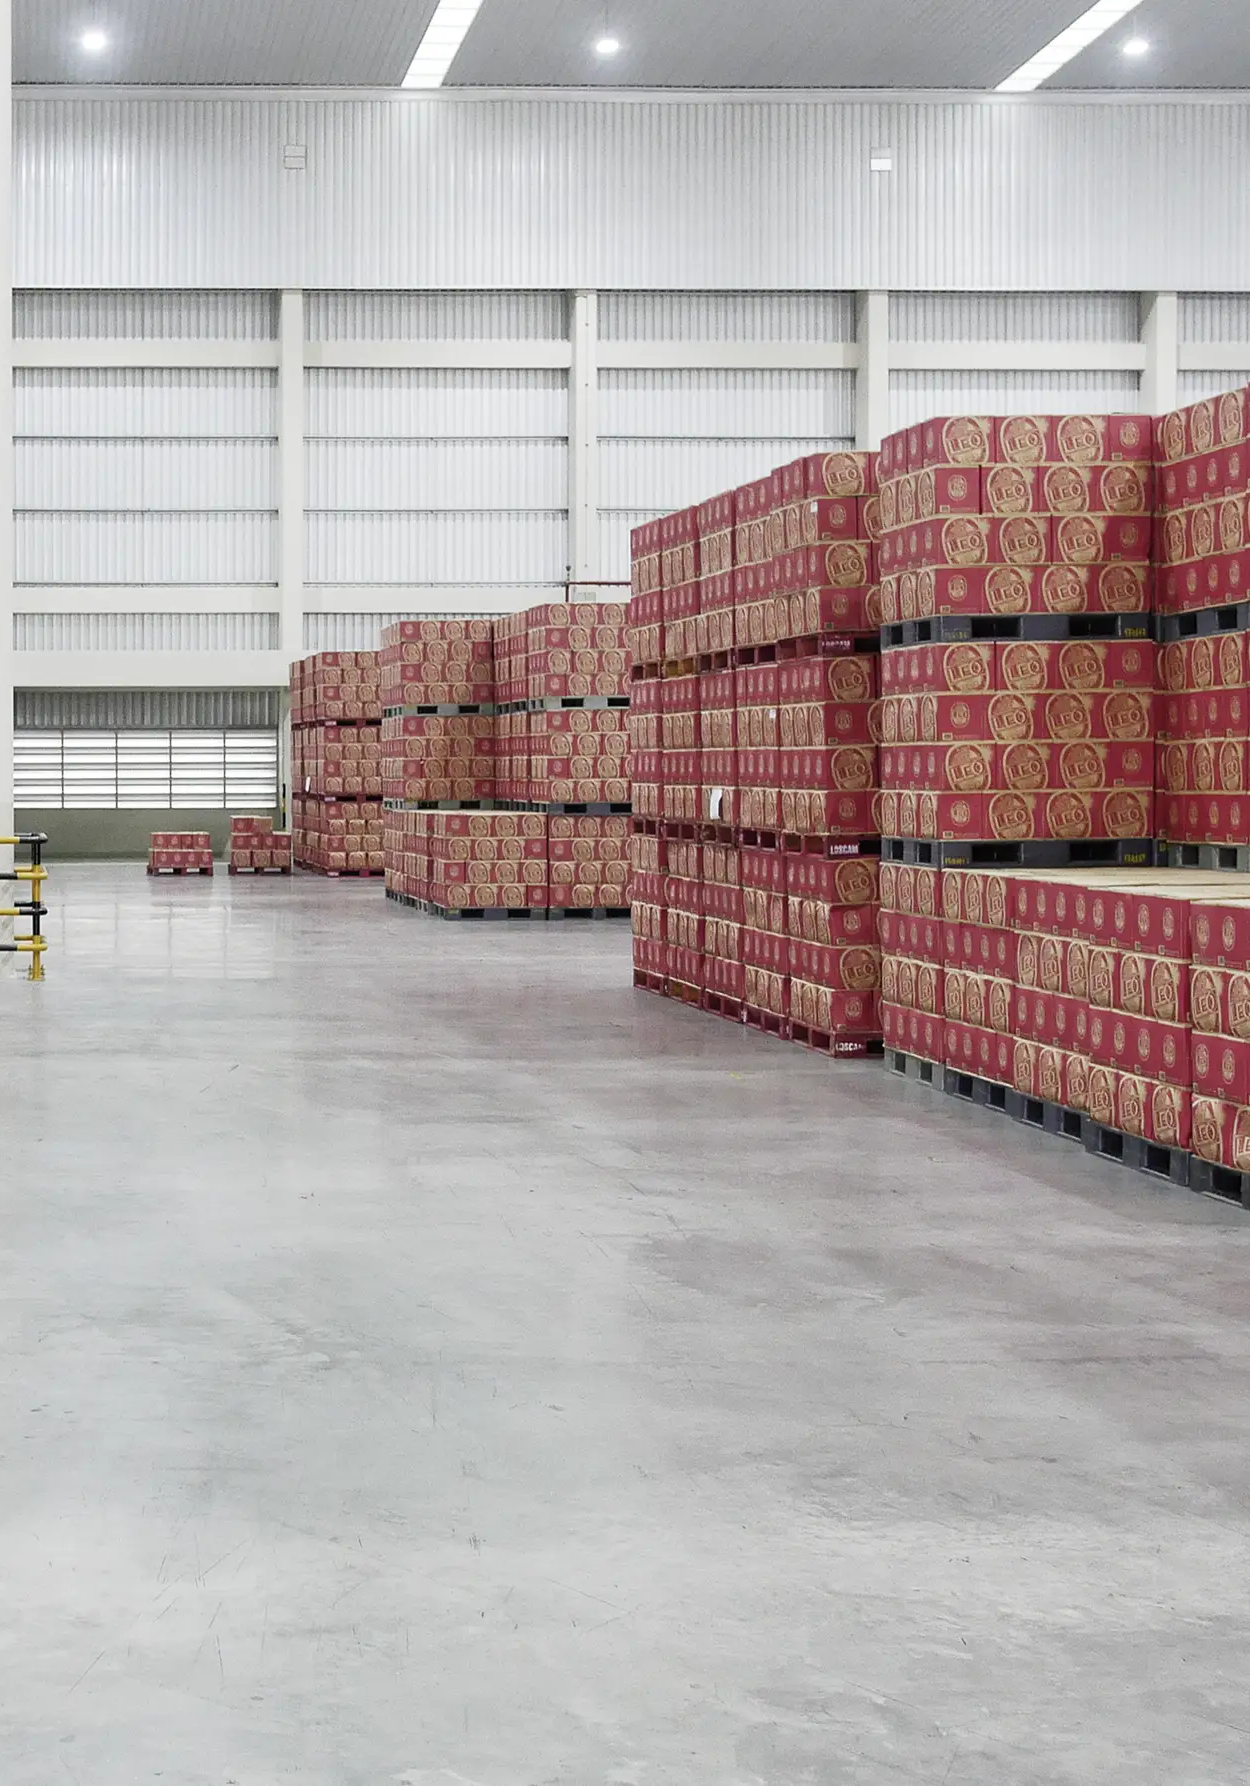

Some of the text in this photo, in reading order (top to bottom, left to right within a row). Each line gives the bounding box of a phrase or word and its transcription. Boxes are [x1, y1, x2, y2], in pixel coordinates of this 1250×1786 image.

[948, 433, 984, 453] LEO
[1006, 432, 1041, 452] LEO
[1062, 432, 1098, 452] LEO
[828, 467, 859, 485] LEO
[992, 482, 1027, 502] LEO
[1049, 482, 1084, 502] LEO
[1105, 481, 1140, 501] LEO
[947, 533, 982, 553] LEO
[1005, 533, 1040, 553] LEO
[1063, 531, 1098, 551] LEO
[831, 558, 862, 576] LEO
[991, 583, 1026, 603] LEO
[1047, 582, 1082, 602] LEO
[1104, 581, 1139, 601] LEO
[949, 660, 984, 680] LEO
[1007, 659, 1042, 679] LEO
[1064, 658, 1099, 678] LEO
[834, 673, 865, 691] LEO
[993, 709, 1028, 729] LEO
[1051, 708, 1086, 728] LEO
[1108, 708, 1143, 728] LEO
[837, 762, 868, 780] LEO
[951, 760, 986, 780] LEO
[1008, 759, 1043, 779] LEO
[1065, 758, 1100, 778] LEO
[994, 808, 1029, 828] LEO
[1052, 807, 1087, 827] LEO
[1108, 807, 1142, 826] LEO
[841, 875, 872, 893] LEO
[845, 962, 876, 980] LEO
[1195, 992, 1215, 1017] LEO
[1196, 1123, 1216, 1143] LEO
